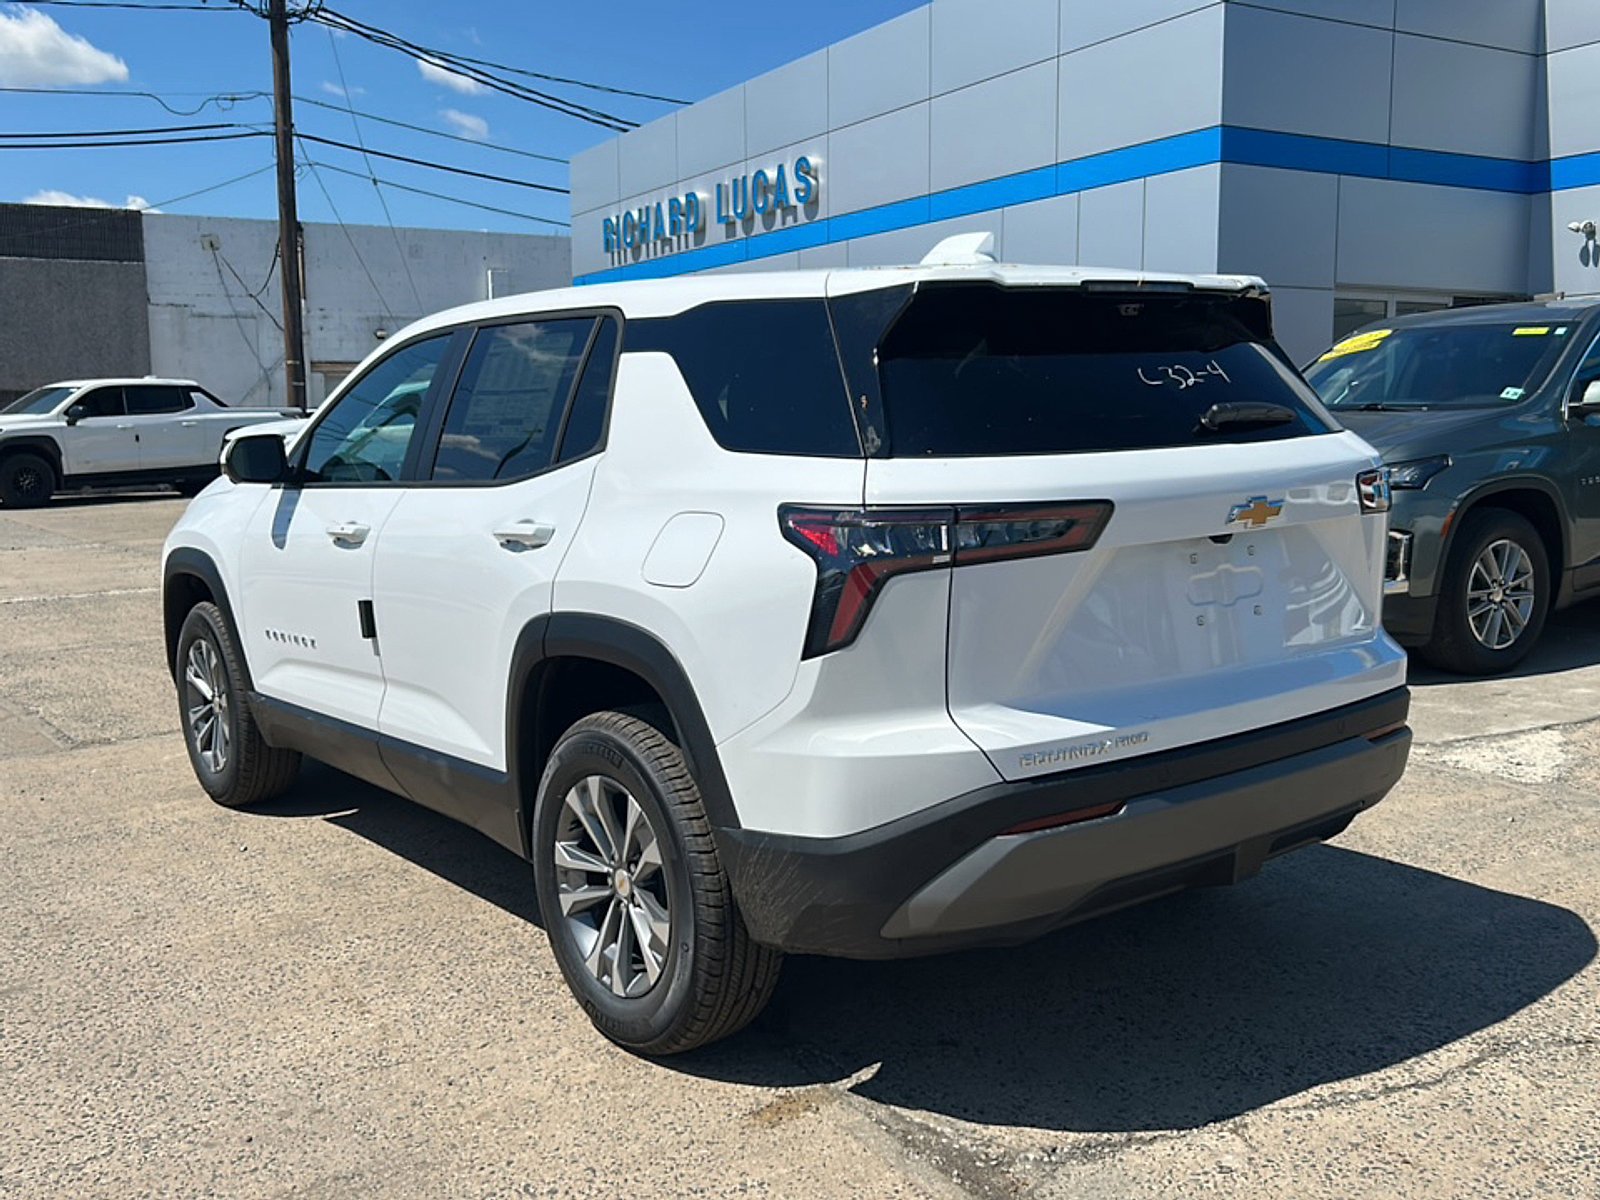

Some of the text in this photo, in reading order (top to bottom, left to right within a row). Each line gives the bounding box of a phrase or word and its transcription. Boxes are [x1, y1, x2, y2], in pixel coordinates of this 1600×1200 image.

[603, 156, 813, 253] RICHARD LUCAS
[1019, 738, 1112, 769] EQUINOX
